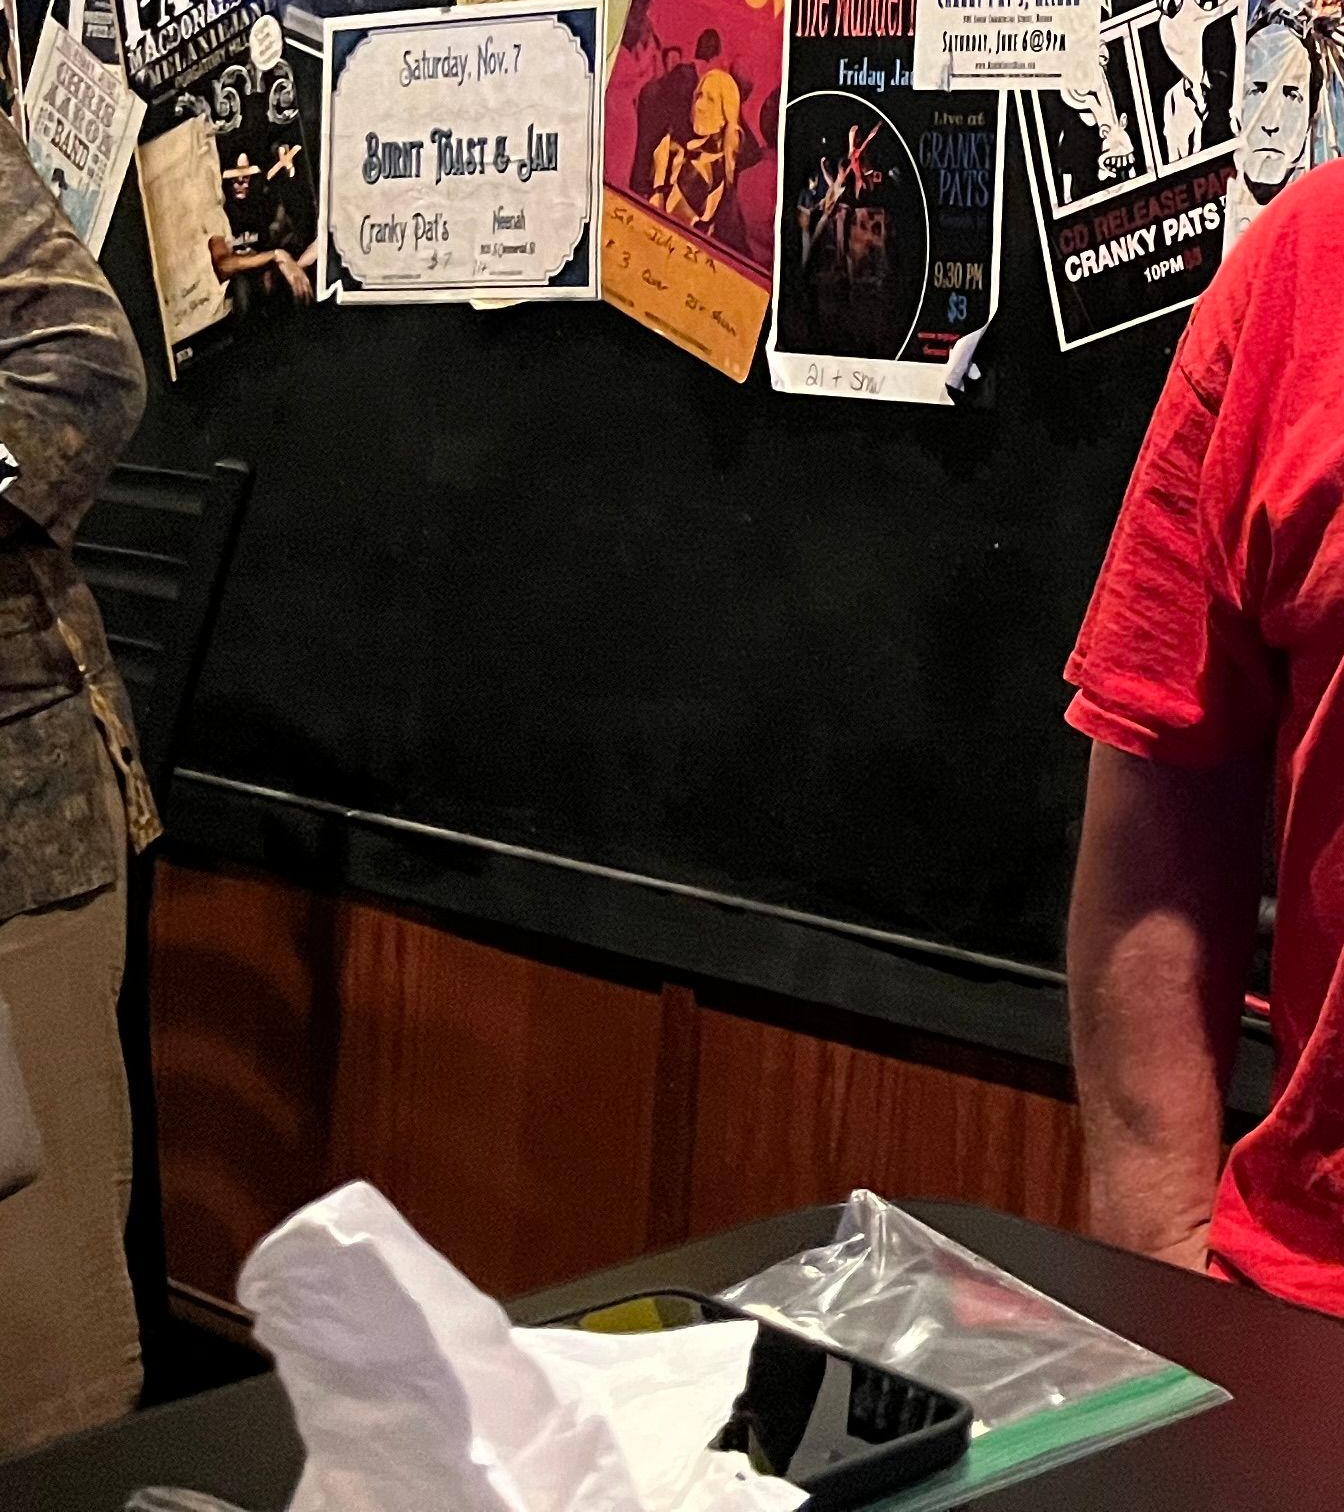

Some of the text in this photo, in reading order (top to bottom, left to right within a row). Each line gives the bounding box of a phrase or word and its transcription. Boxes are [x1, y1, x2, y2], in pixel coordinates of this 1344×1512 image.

[477, 35, 509, 81] Nov.
[512, 43, 522, 69] 7
[995, 29, 1019, 56] JUNE
[838, 56, 886, 93] Friday
[933, 111, 987, 127] Live at
[50, 117, 91, 172] BAND
[362, 131, 424, 185] BURNT
[430, 127, 488, 186] TOAST
[492, 135, 511, 174] &
[919, 131, 994, 170] CRANKY
[938, 169, 990, 207] PATS
[1060, 166, 1236, 254] CD RELEASE PAR
[360, 213, 408, 255] Cranky
[412, 211, 450, 252] Pat's
[1064, 223, 1157, 284] CRANKY
[1162, 201, 1221, 246] PATS
[965, 262, 984, 291] PM
[1143, 254, 1185, 284] 10PM
[947, 292, 968, 323] $3
